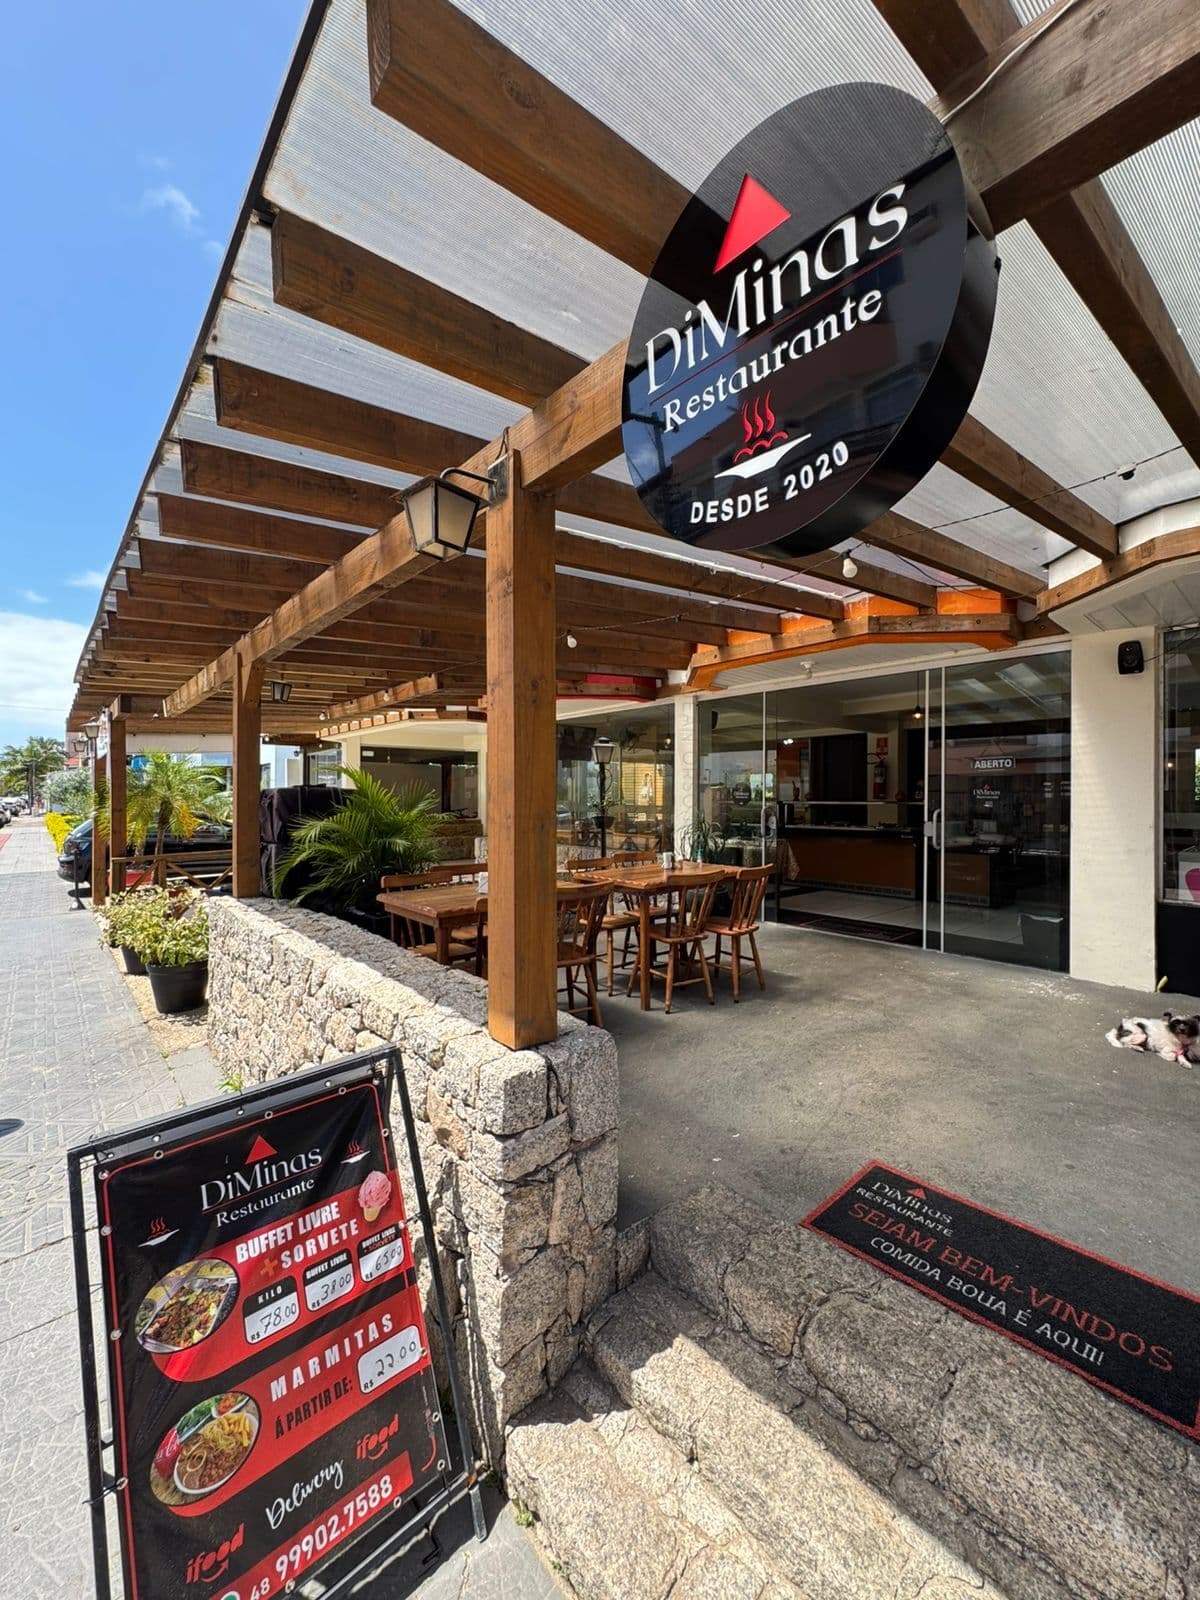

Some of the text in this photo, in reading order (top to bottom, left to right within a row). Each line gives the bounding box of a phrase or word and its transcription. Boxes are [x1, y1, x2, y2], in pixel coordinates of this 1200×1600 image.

[646, 184, 909, 395] DiMinas
[662, 288, 882, 433] Restaurante
[690, 440, 849, 525] DESDE 2020
[974, 758, 1012, 769] ABERTO
[201, 1148, 322, 1210] DiMinas
[216, 1178, 315, 1227] Restaurante
[236, 1201, 340, 1264] BUFFET LIVRE
[856, 1187, 954, 1237] RESTAURANTE
[281, 1219, 359, 1269] SORVETE
[306, 1253, 347, 1279] BUFFET LIVRE
[258, 1285, 282, 1304] KILO
[848, 1202, 1173, 1373] SEJAM BEM-VINDOS
[869, 1236, 942, 1283] COMIDA
[946, 1275, 1007, 1316] BOUA
[1013, 1309, 1032, 1327] É
[251, 1332, 260, 1342] R$
[270, 1313, 393, 1402] MARMITAS
[286, 1387, 332, 1431] PARTIR
[333, 1376, 353, 1401] DE:
[363, 1379, 374, 1391] R$
[356, 1413, 399, 1460] ifood
[265, 1459, 344, 1530] Delivery
[186, 1522, 246, 1584] ifood
[250, 1474, 393, 1600] 48 99902.7588
